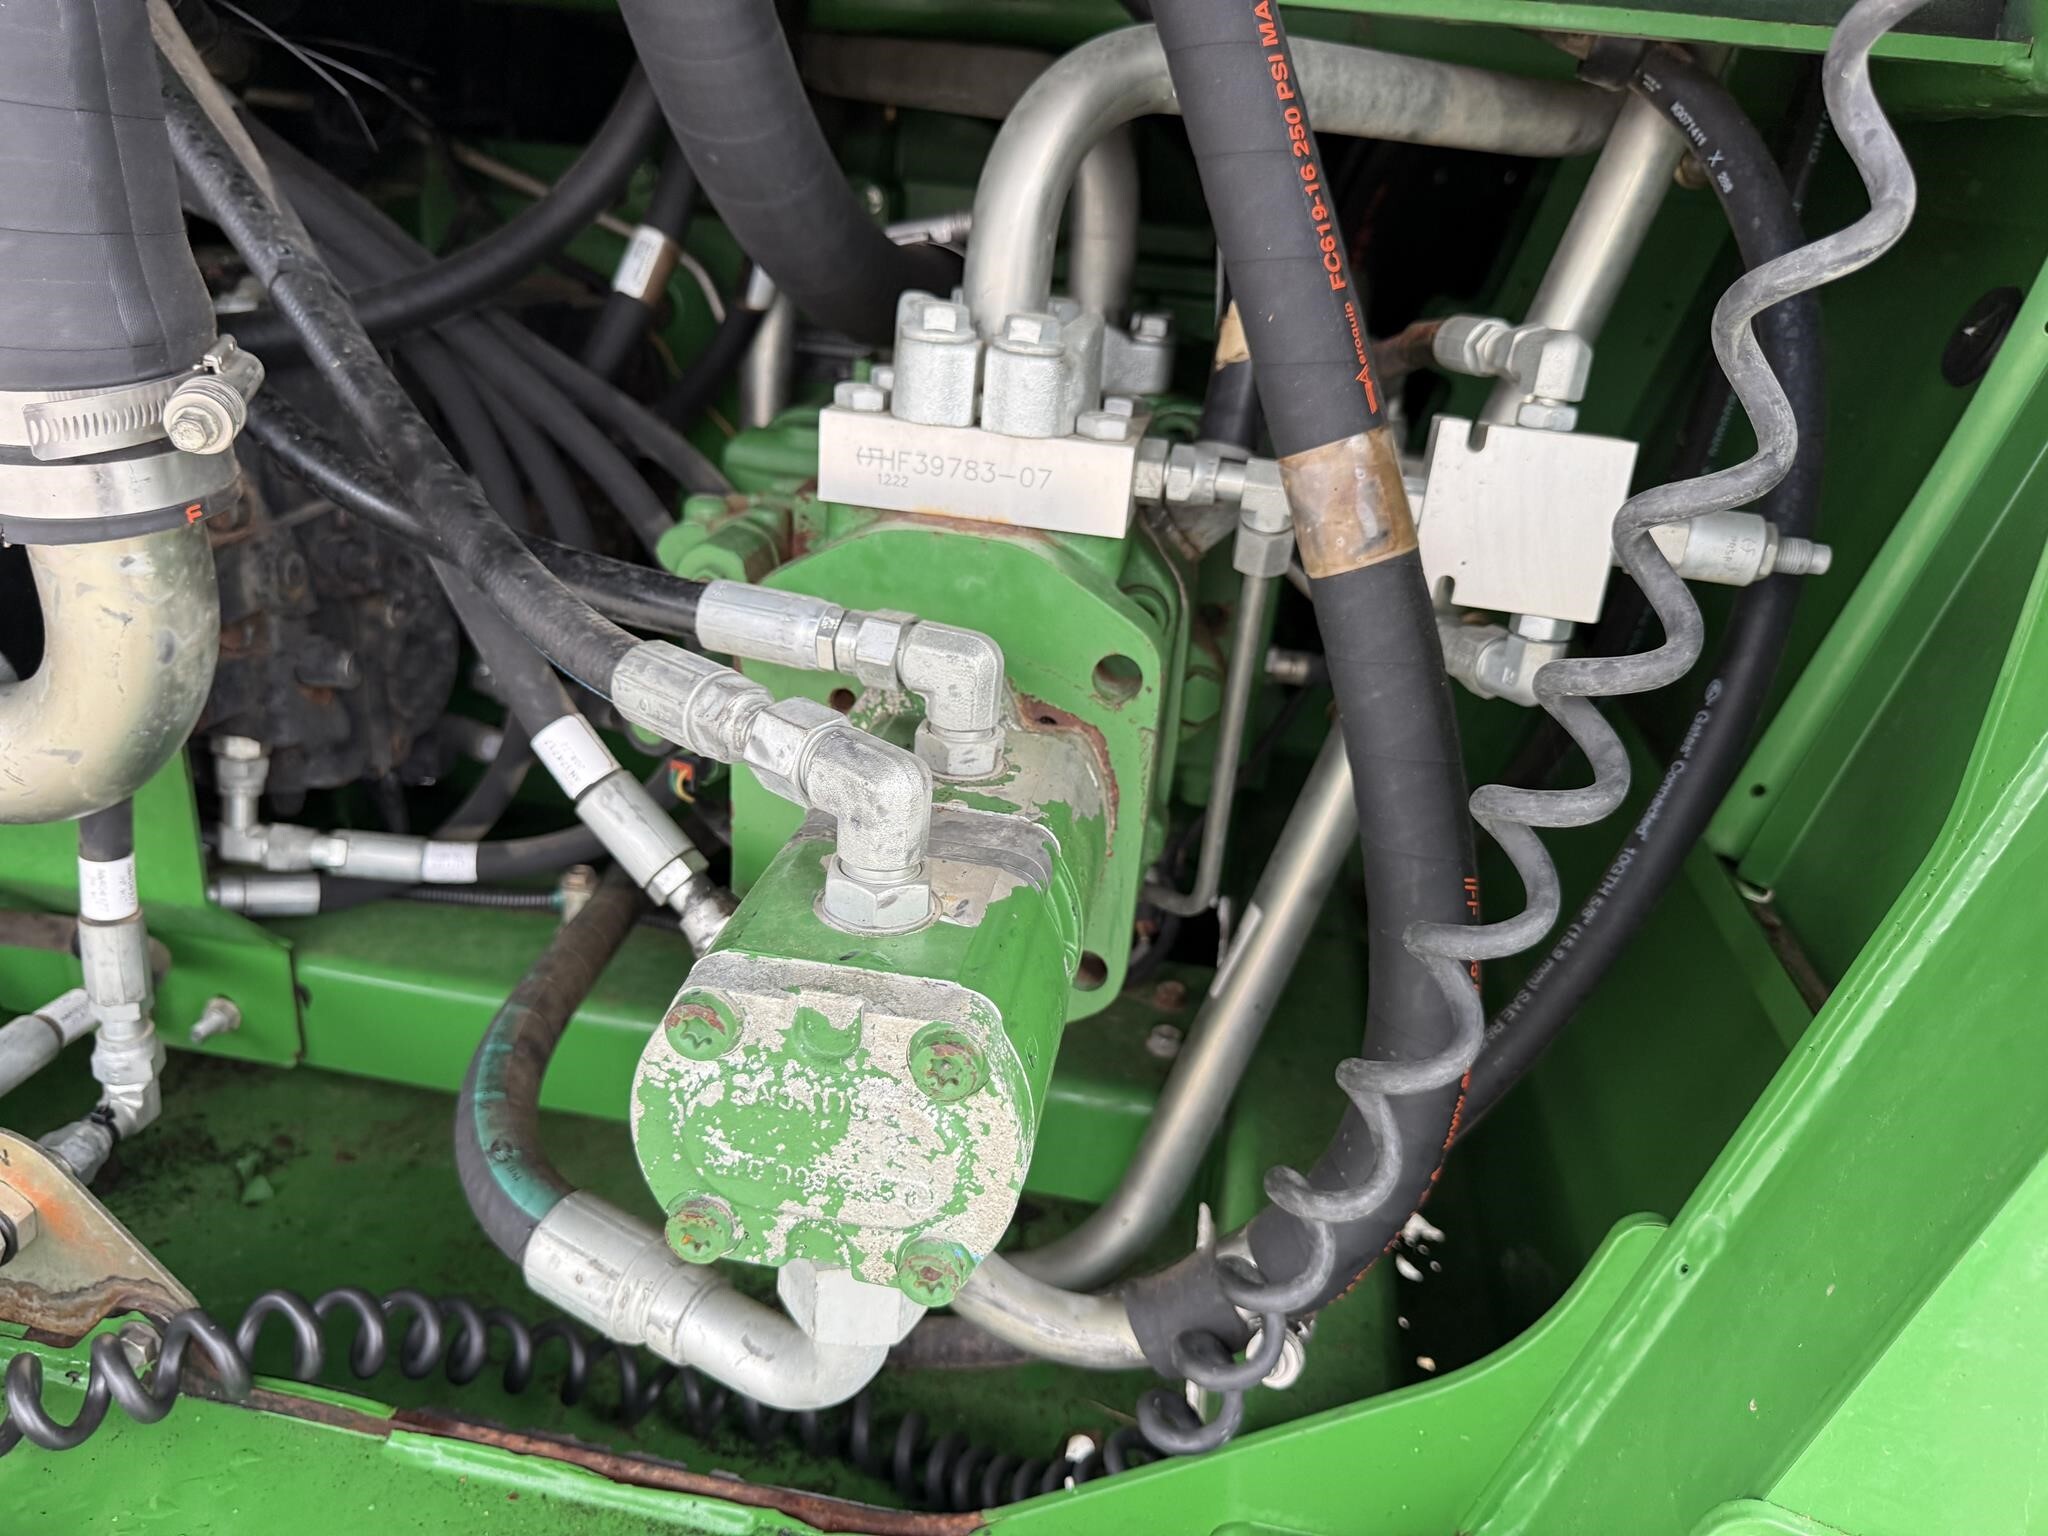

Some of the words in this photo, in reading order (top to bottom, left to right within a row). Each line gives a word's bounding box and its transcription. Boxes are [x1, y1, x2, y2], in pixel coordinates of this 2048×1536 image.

[1268, 53, 1294, 100] PSI
[1284, 106, 1310, 157] 250
[1300, 162, 1346, 291] FC619-16
[1345, 302, 1378, 415] Aeroquip
[878, 473, 909, 488] 1222
[1598, 847, 1638, 897] 10GTH
[1503, 989, 1532, 1021] SAE
